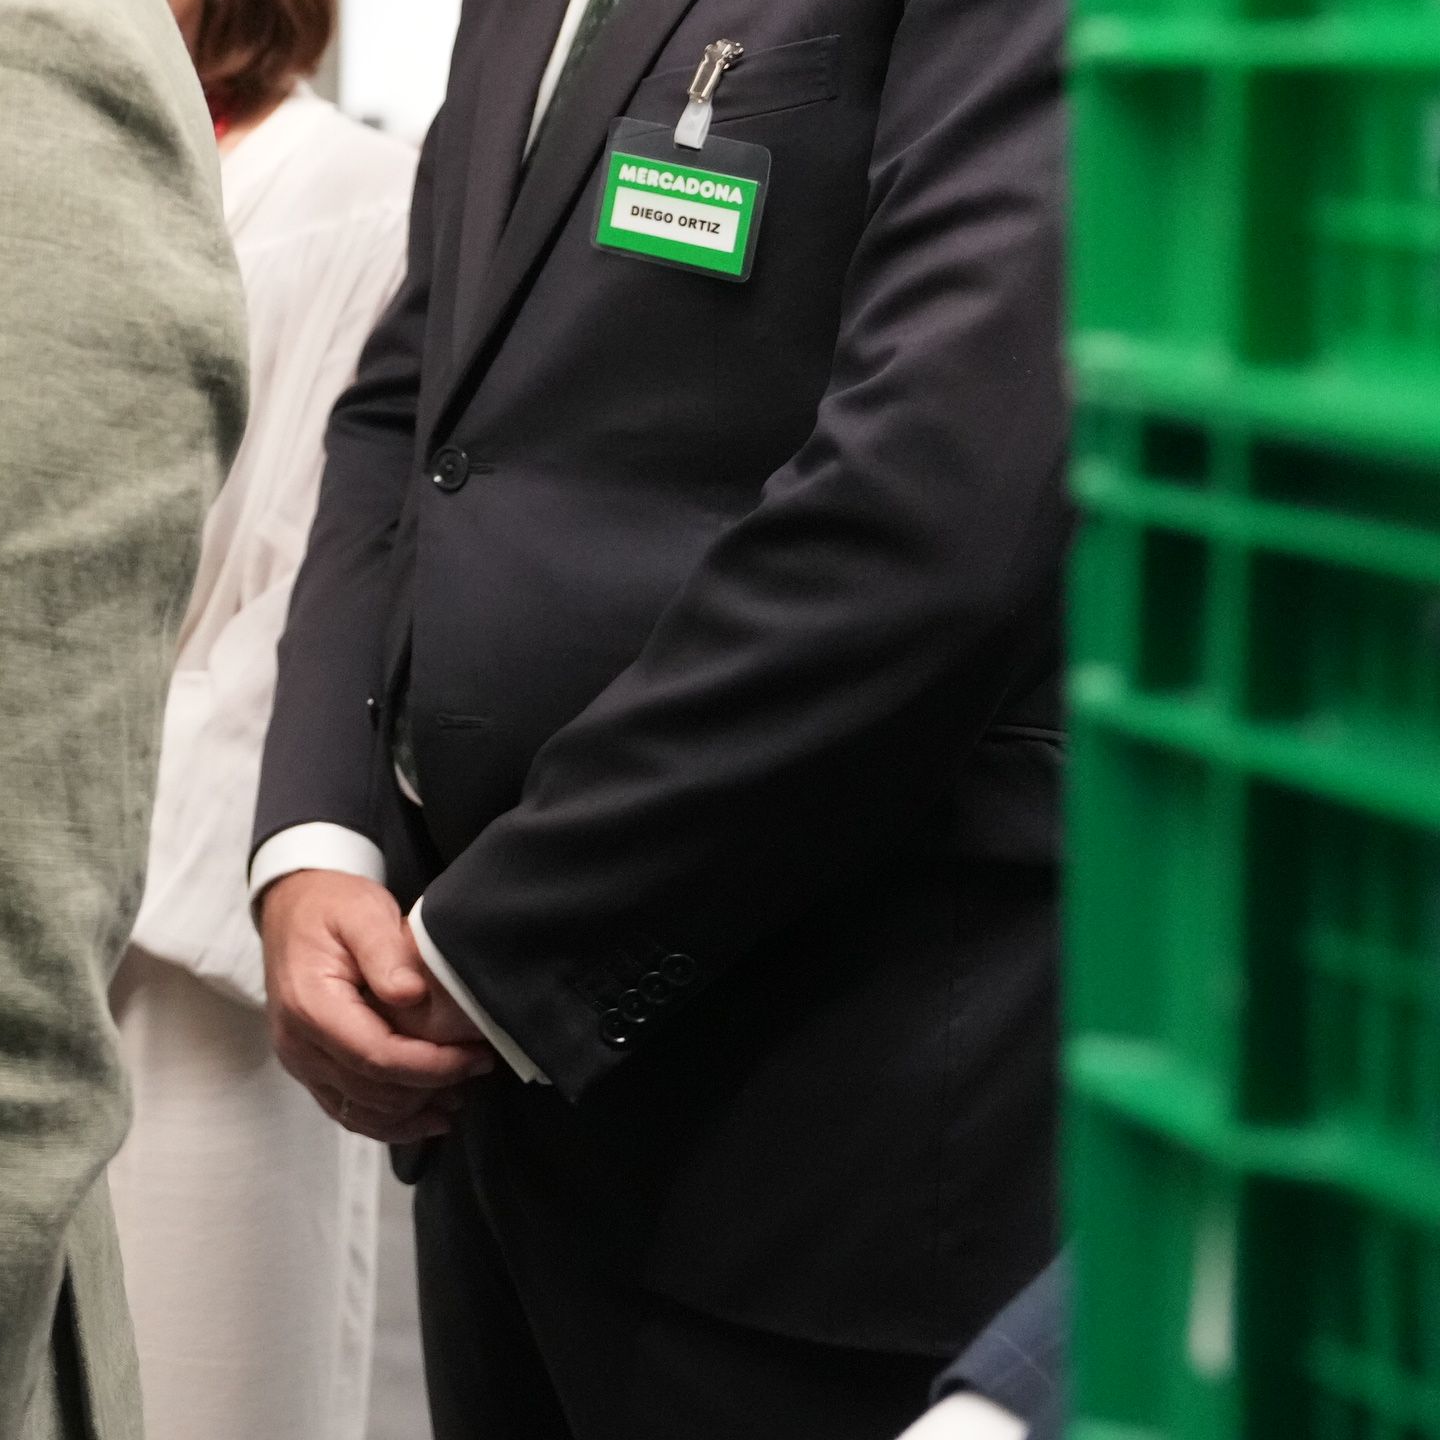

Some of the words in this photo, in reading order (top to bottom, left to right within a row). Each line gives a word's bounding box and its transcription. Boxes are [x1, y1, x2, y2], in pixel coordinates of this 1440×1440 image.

[618, 163, 743, 205] MERCADONA
[630, 205, 673, 224] DIEGO
[678, 215, 721, 235] ORTIZ
